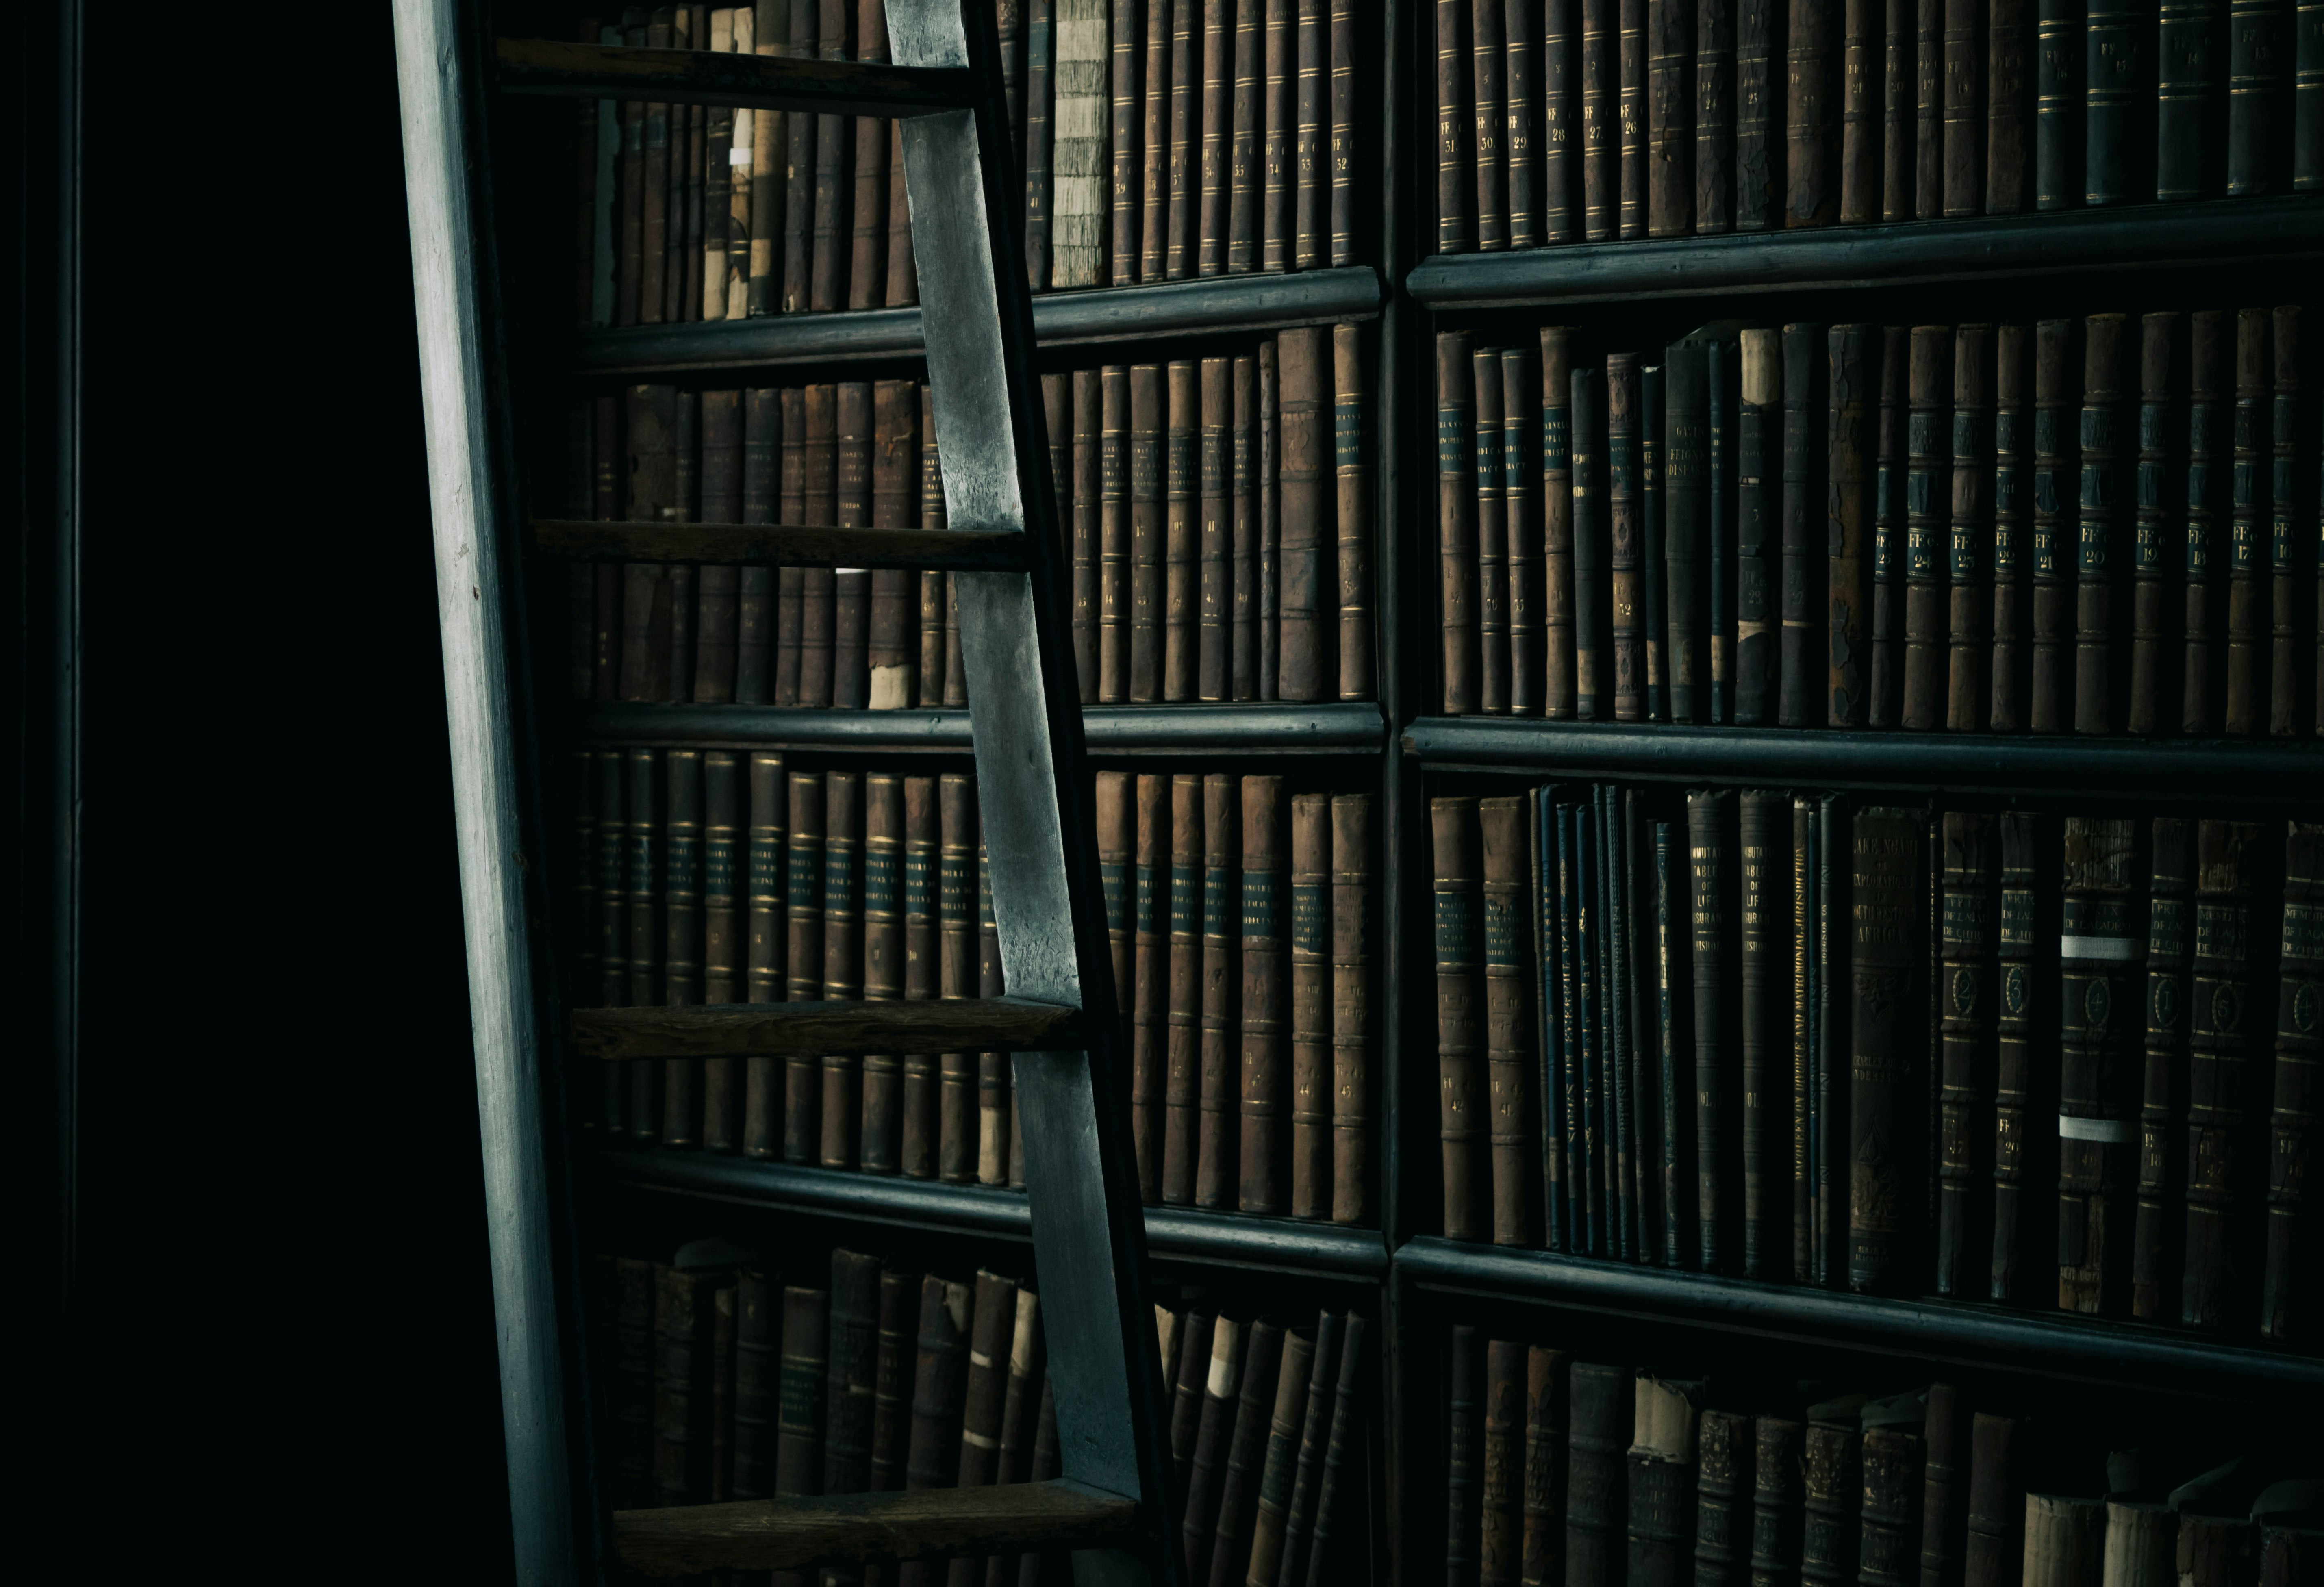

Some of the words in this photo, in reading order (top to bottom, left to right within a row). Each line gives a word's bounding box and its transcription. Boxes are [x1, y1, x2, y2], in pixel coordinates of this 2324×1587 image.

[1753, 509, 1759, 521] 3
[1796, 510, 1803, 523] 2
[1910, 533, 1925, 548] FF.
[1879, 554, 1892, 565] 25
[1999, 551, 2015, 564] 22
[1701, 881, 1712, 890] OF
[1751, 881, 1759, 890] OF
[1698, 895, 1720, 907] LIFE
[1746, 895, 1767, 907] LIFE
[1944, 911, 1954, 920] DE
[2003, 910, 2013, 919] DE
[2066, 919, 2075, 927] DE
[2154, 921, 2164, 929] DE
[1944, 926, 1953, 936] DE
[2152, 938, 2162, 947] DE
[1958, 979, 1970, 999] 2
[2011, 978, 2020, 999] 3
[2090, 992, 2102, 1011] 4
[2299, 996, 2311, 1015] 4
[2218, 1000, 2228, 1017] 5
[1795, 1014, 1804, 1038] AND
[1795, 1042, 1804, 1091] DIVORCE
[1795, 1096, 1804, 1112] ON
[1795, 1116, 1804, 1181] MACQUEEN
